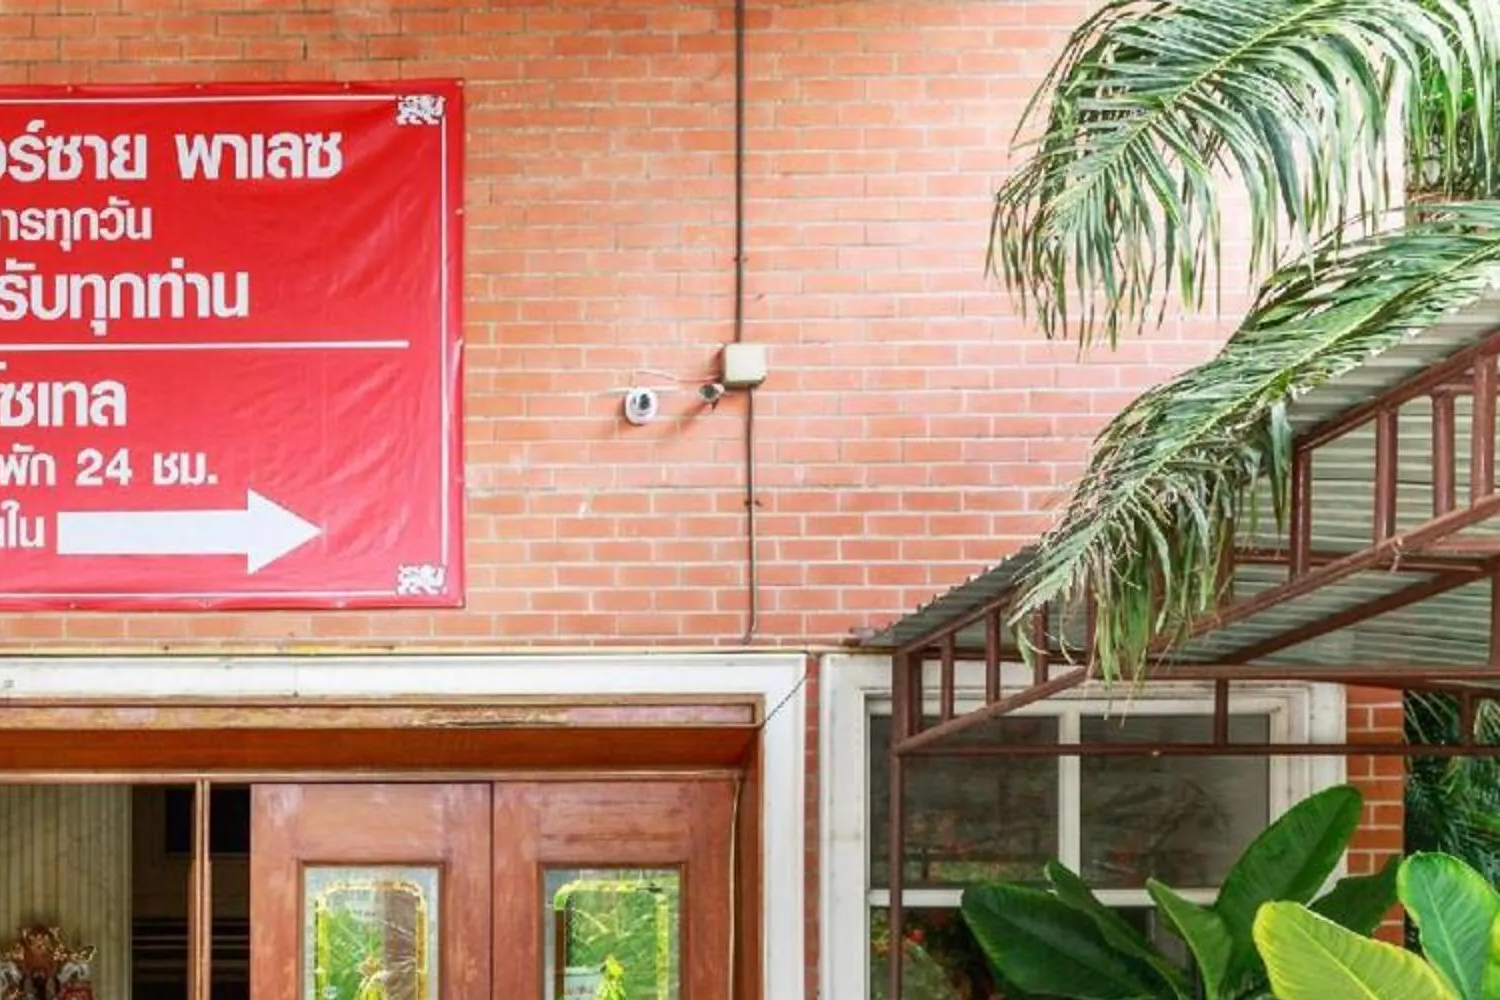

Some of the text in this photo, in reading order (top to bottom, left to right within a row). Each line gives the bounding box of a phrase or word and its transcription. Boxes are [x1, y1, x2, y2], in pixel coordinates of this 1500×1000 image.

[174, 132, 343, 180] พาเลซ
[74, 447, 134, 487] 24
[152, 451, 219, 487] ชม.
